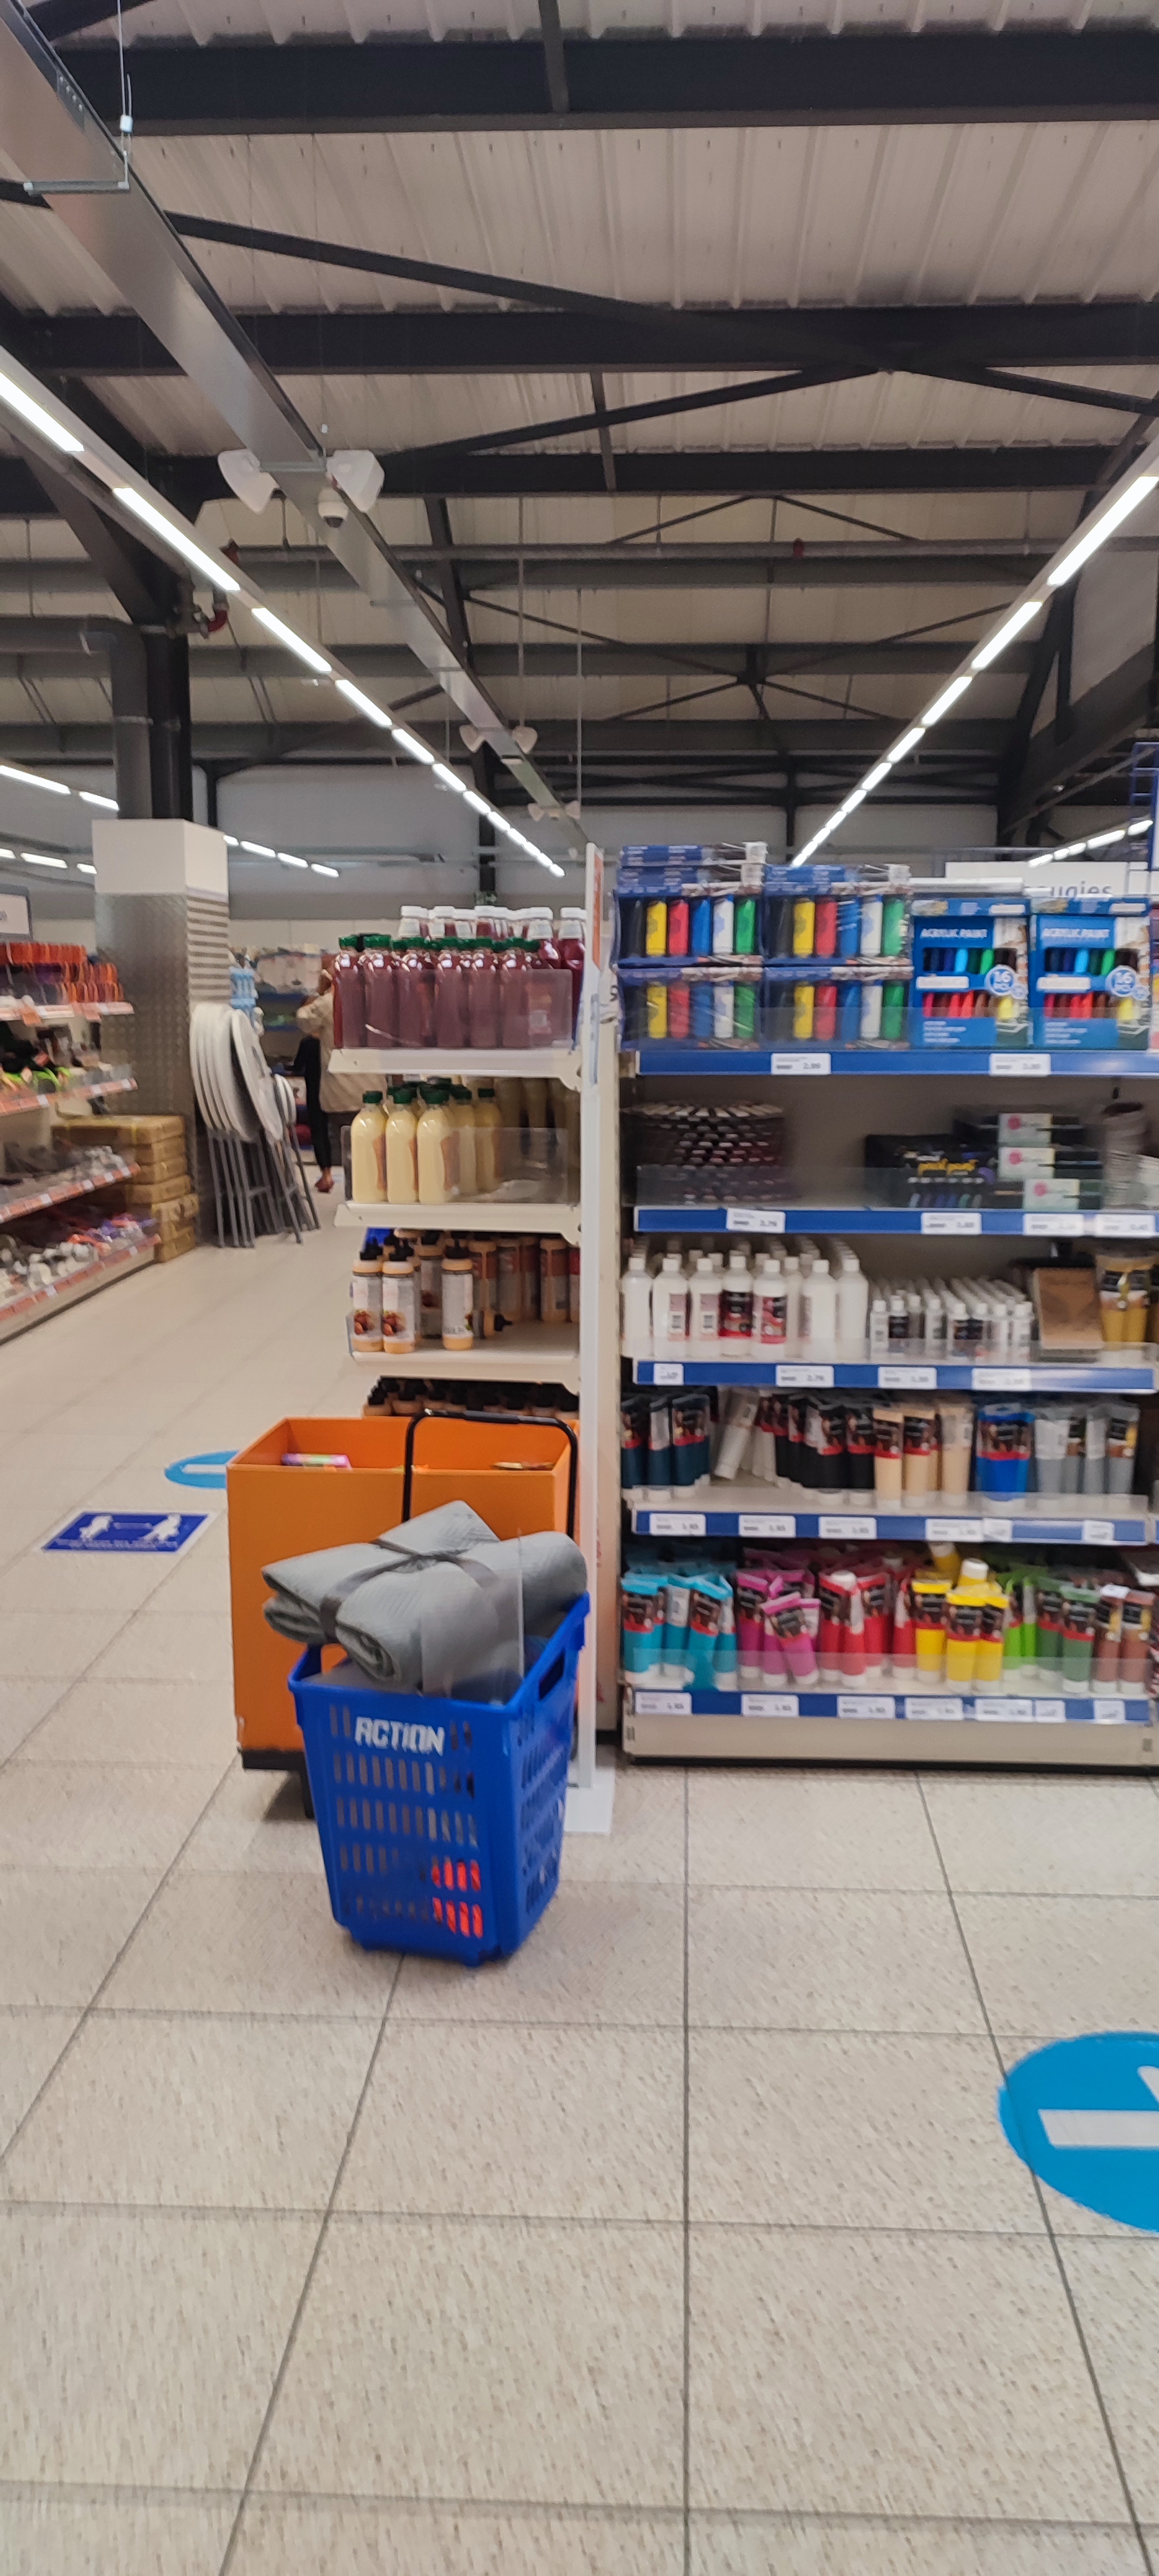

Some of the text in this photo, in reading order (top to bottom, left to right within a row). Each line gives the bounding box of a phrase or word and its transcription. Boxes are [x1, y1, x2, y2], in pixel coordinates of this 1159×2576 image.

[994, 971, 1012, 983] 16
[1115, 972, 1133, 983] 16
[355, 1716, 445, 1756] ACTION
